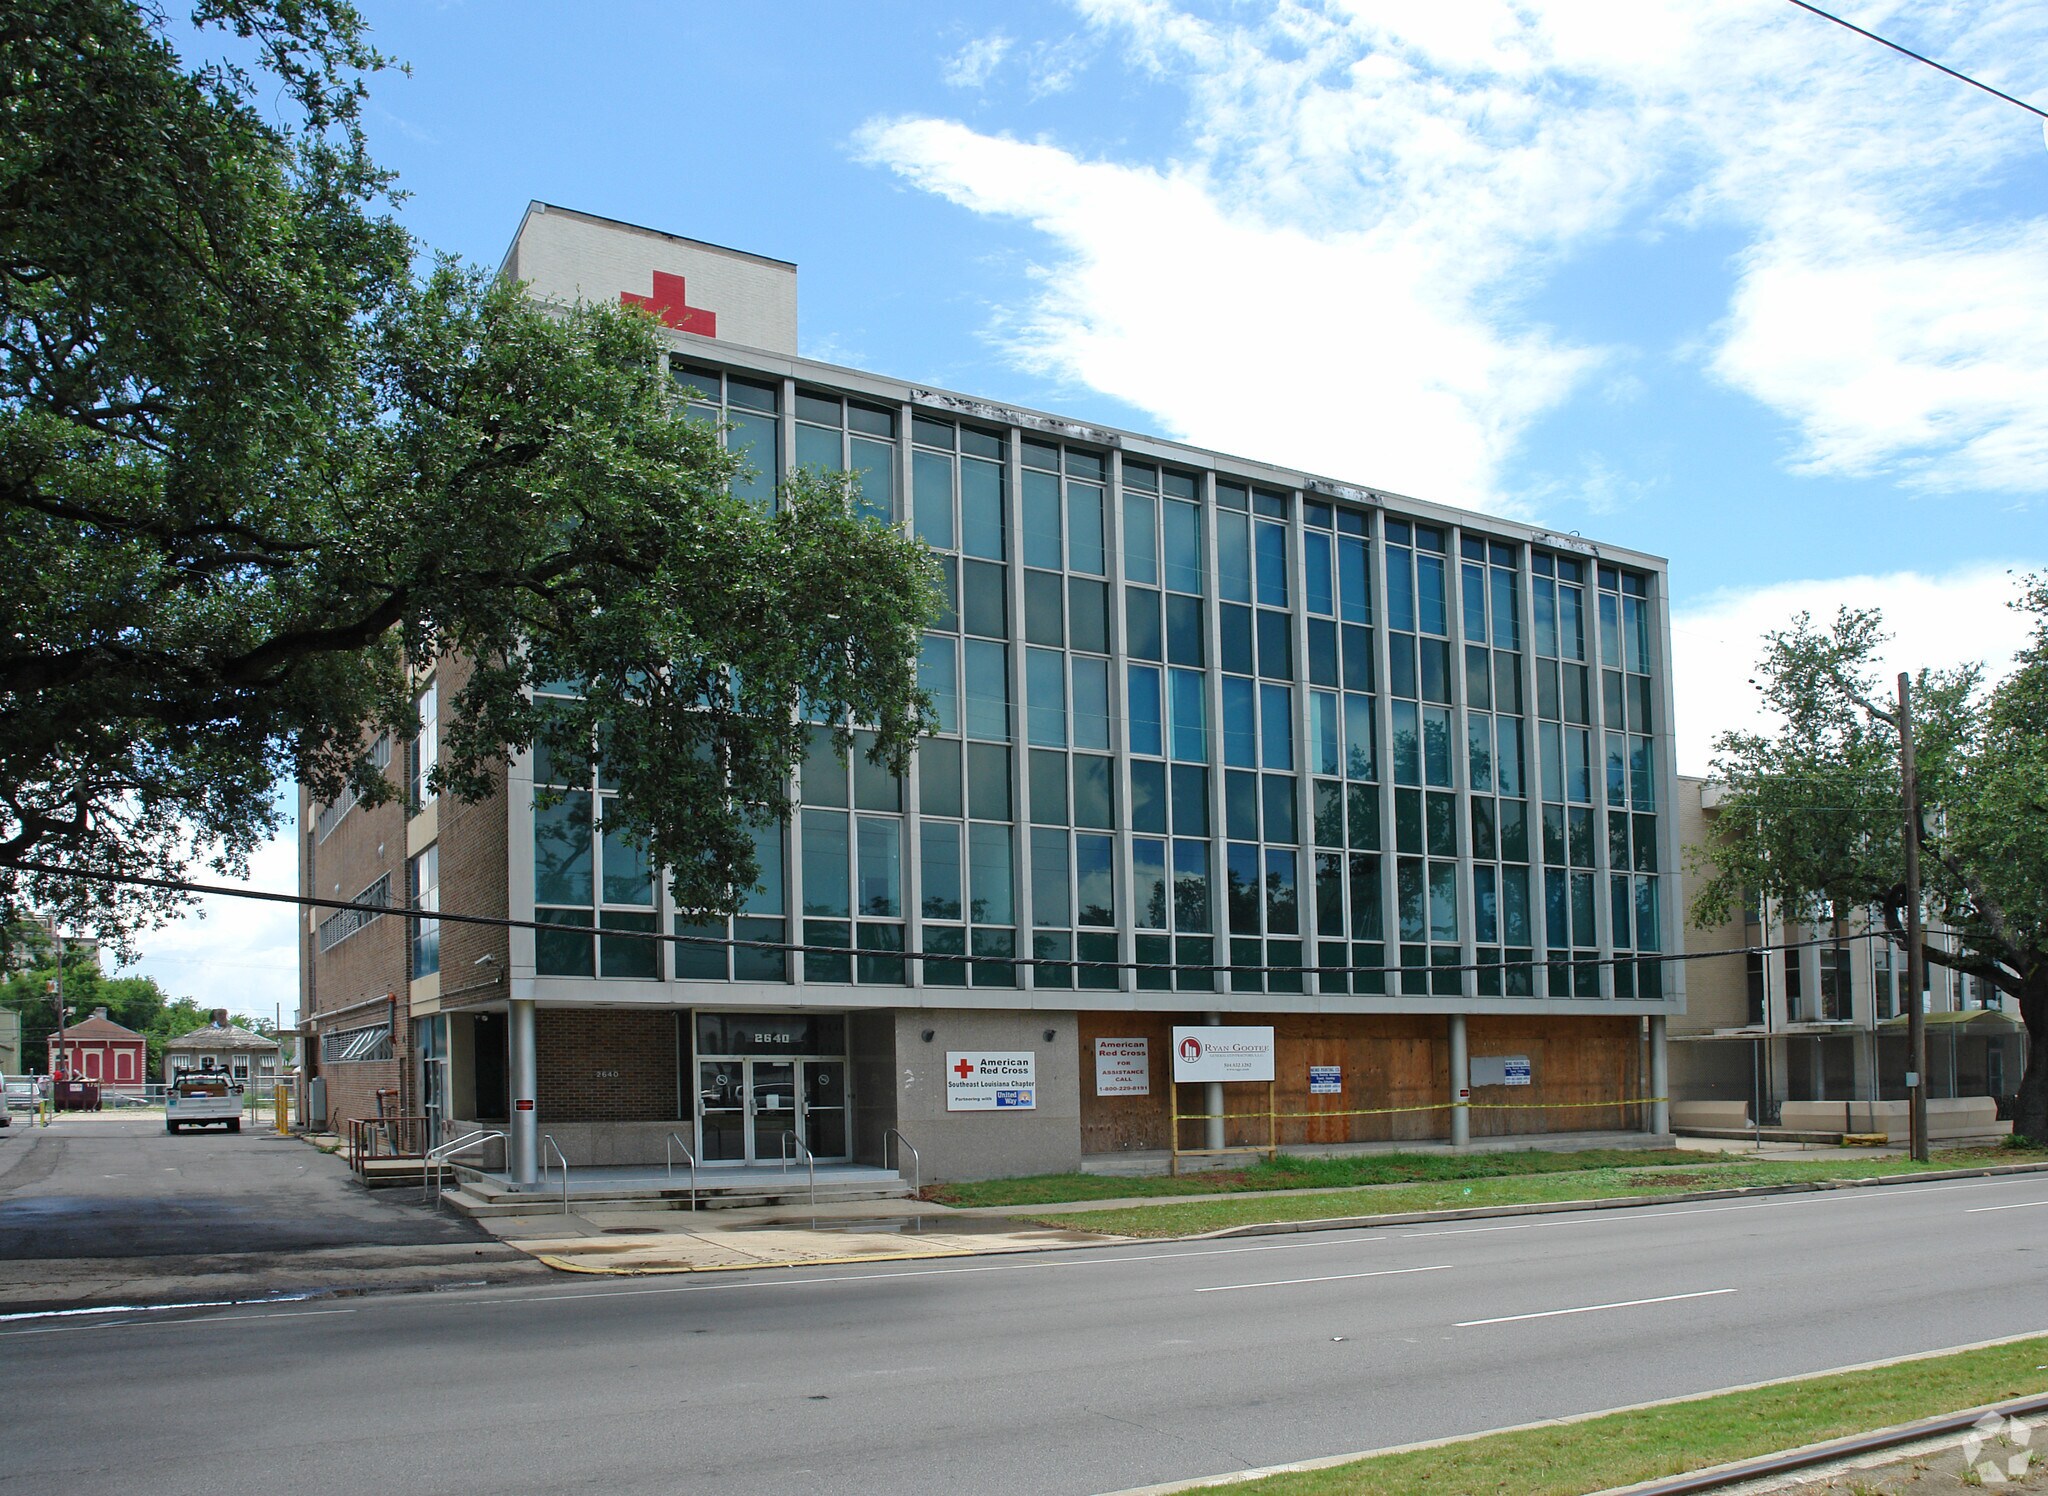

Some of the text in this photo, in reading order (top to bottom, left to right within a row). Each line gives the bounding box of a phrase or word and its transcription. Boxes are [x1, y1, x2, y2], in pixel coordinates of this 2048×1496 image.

[754, 1033, 790, 1043] 2640
[1204, 1043, 1230, 1052] RYAN
[980, 1058, 1029, 1066] American
[1001, 1066, 1029, 1074] Cross
[1011, 1080, 1035, 1088] Chapter
[1005, 1097, 1017, 1105] Way
